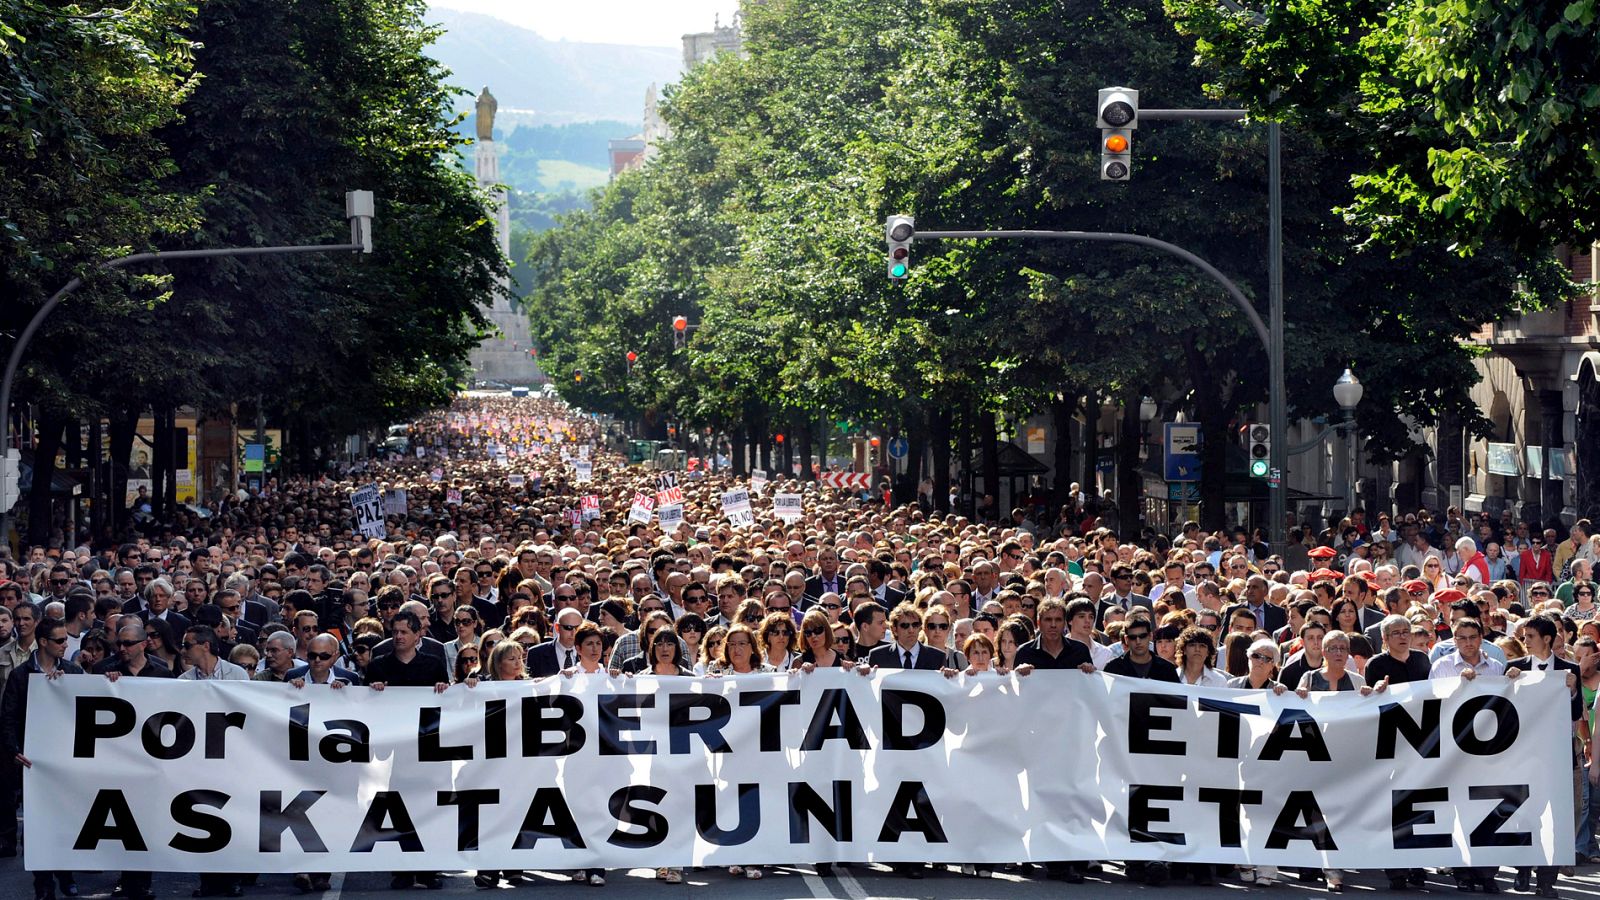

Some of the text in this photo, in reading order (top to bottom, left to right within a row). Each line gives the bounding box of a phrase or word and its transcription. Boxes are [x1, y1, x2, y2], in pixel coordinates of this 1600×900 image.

[655, 472, 678, 492] PAZ
[580, 495, 599, 508] PAZ
[633, 492, 655, 510] PAZ
[668, 487, 681, 502] NO
[356, 501, 383, 525] PAZ
[563, 510, 581, 525] PAZ
[74, 688, 947, 763] Por la LIBERTAD
[1129, 693, 1520, 762] ETA NO
[73, 780, 948, 854] ASKATASUNA
[1128, 785, 1533, 851] ETA EZ
